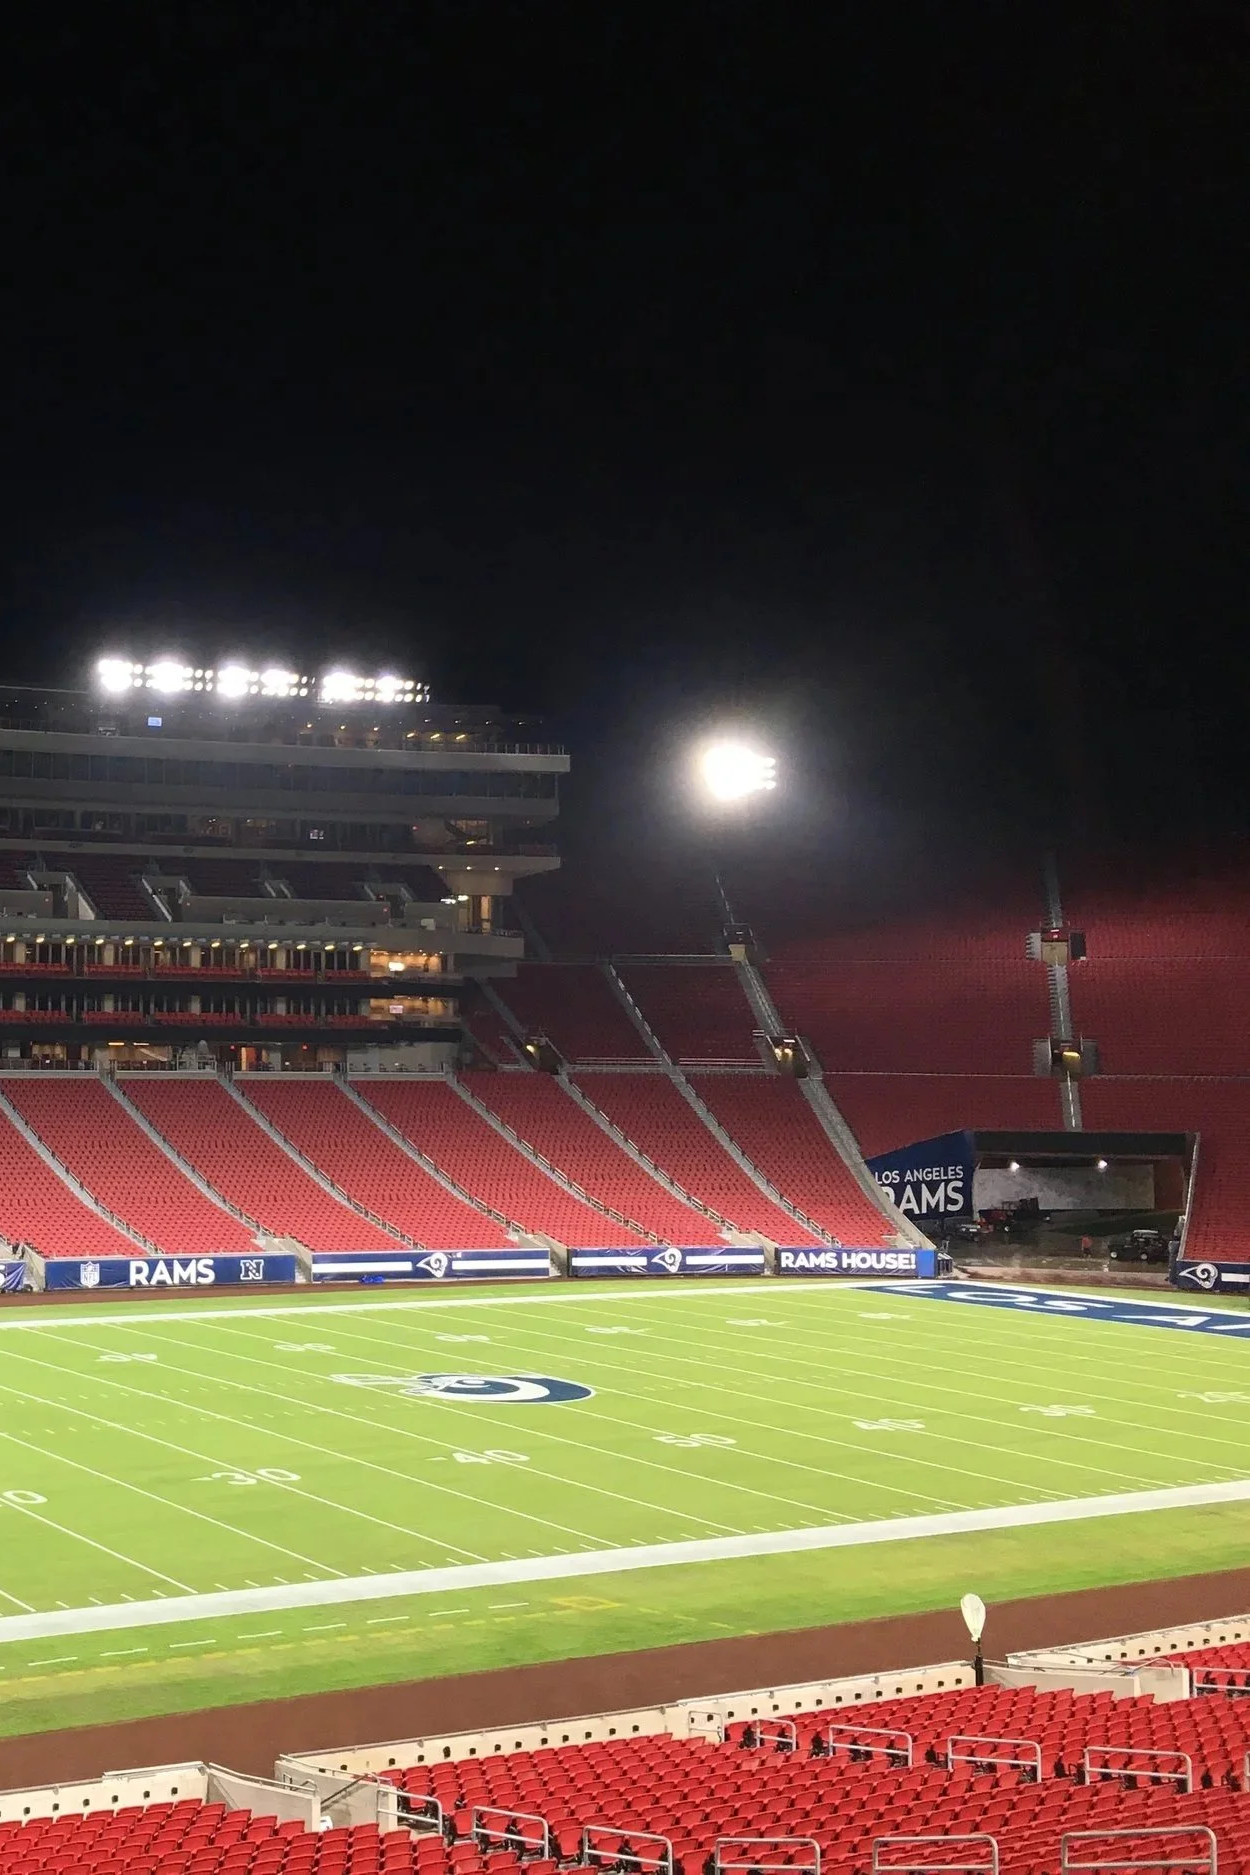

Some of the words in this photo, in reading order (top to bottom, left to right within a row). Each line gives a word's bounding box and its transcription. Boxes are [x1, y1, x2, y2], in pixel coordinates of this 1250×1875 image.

[875, 1170, 900, 1184] LOS
[904, 1166, 964, 1182] ANGELES
[780, 1251, 838, 1269] RAMS
[841, 1251, 917, 1269] HOUSE!
[129, 1258, 216, 1286] RAMS
[452, 1449, 531, 1465] 40
[211, 1468, 302, 1485] 30
